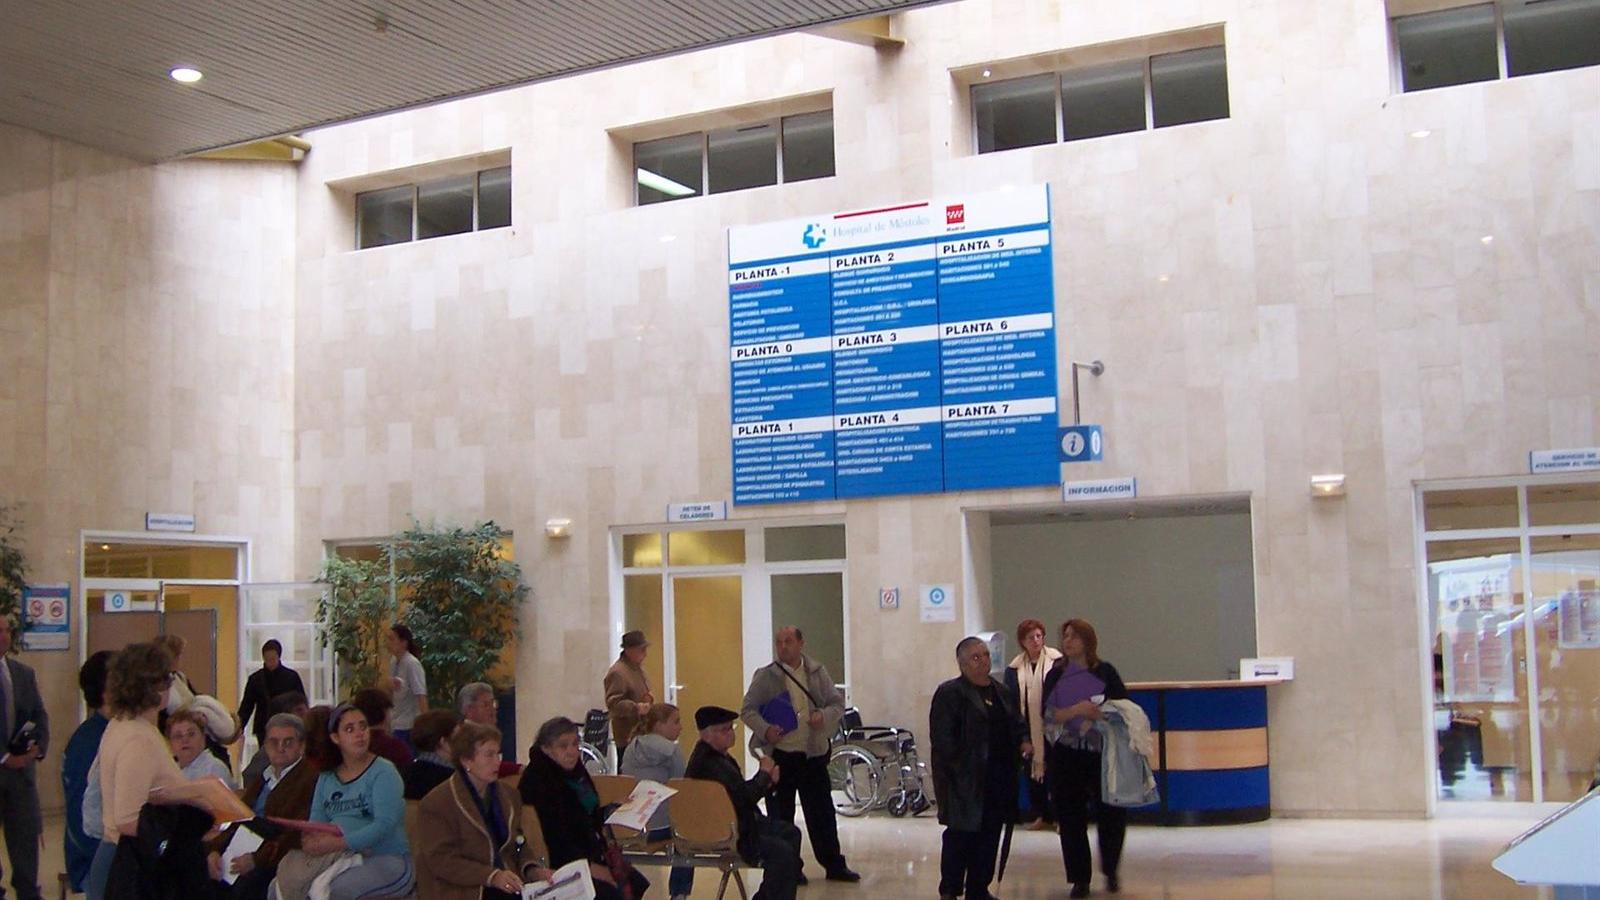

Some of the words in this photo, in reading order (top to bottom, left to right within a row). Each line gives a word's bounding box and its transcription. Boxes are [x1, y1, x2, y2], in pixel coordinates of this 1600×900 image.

[833, 223, 871, 237] Hospital
[874, 222, 886, 232] de
[943, 240, 990, 254] PLANTA
[998, 239, 1005, 247] 5
[836, 254, 881, 268] PLANTA
[888, 253, 894, 261] 2
[736, 268, 778, 280] PLANTA
[945, 323, 993, 335] PLANTA
[1000, 321, 1008, 330] 6
[838, 334, 883, 347] PLANTA
[890, 333, 897, 341] 3
[737, 345, 779, 357] PLANTA
[786, 344, 792, 352] 0
[948, 405, 996, 418] PLANTA
[1002, 404, 1009, 413] 7
[840, 414, 886, 427] PLANTA
[892, 413, 899, 421] 4
[738, 424, 781, 435] PLANTA
[789, 422, 793, 431] 1
[1068, 484, 1131, 495] INFORMACION
